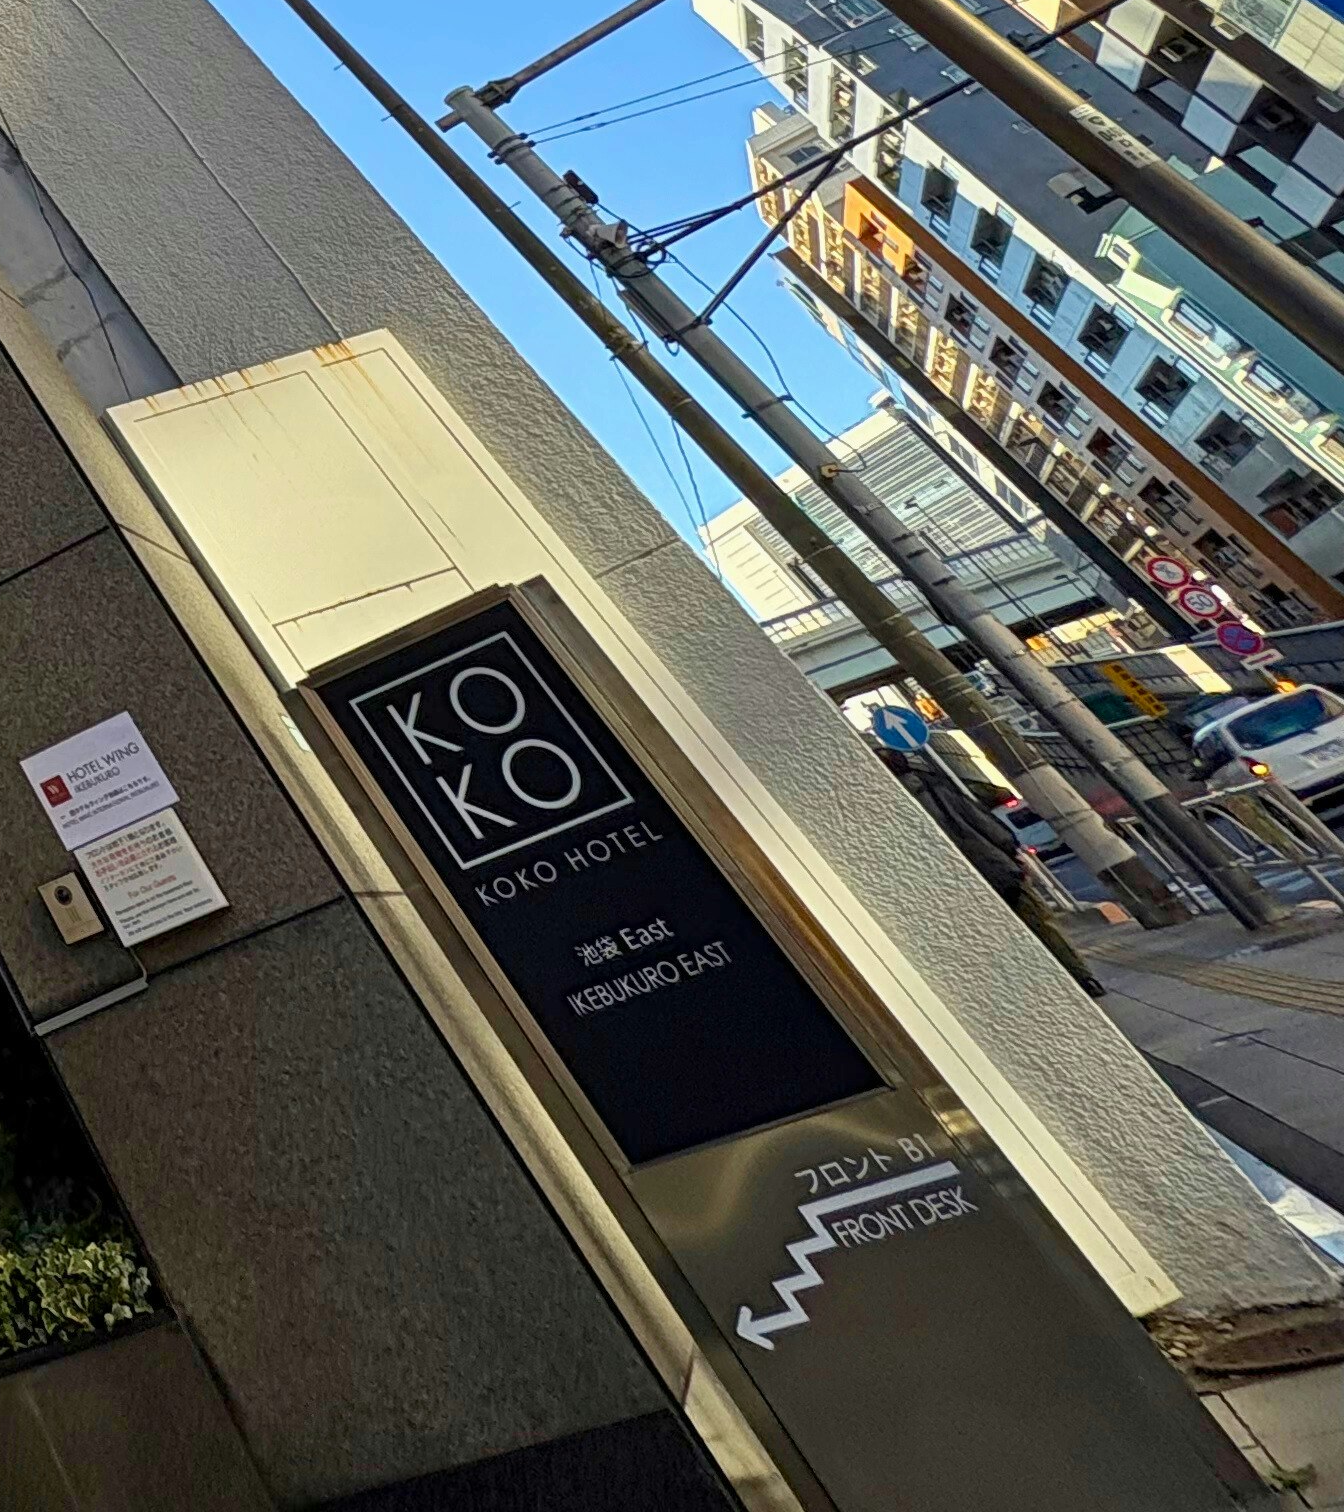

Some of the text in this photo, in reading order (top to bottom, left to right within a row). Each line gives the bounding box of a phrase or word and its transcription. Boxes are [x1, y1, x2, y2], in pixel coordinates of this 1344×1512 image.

[66, 741, 140, 783] HOTEL WING
[475, 821, 663, 906] KOKO HOTEL
[574, 917, 675, 966] 池袋 East
[566, 941, 733, 1016] IKEBUKURO EAST
[793, 1133, 937, 1194] フロント B1
[831, 1185, 980, 1248] FRONT DESK
